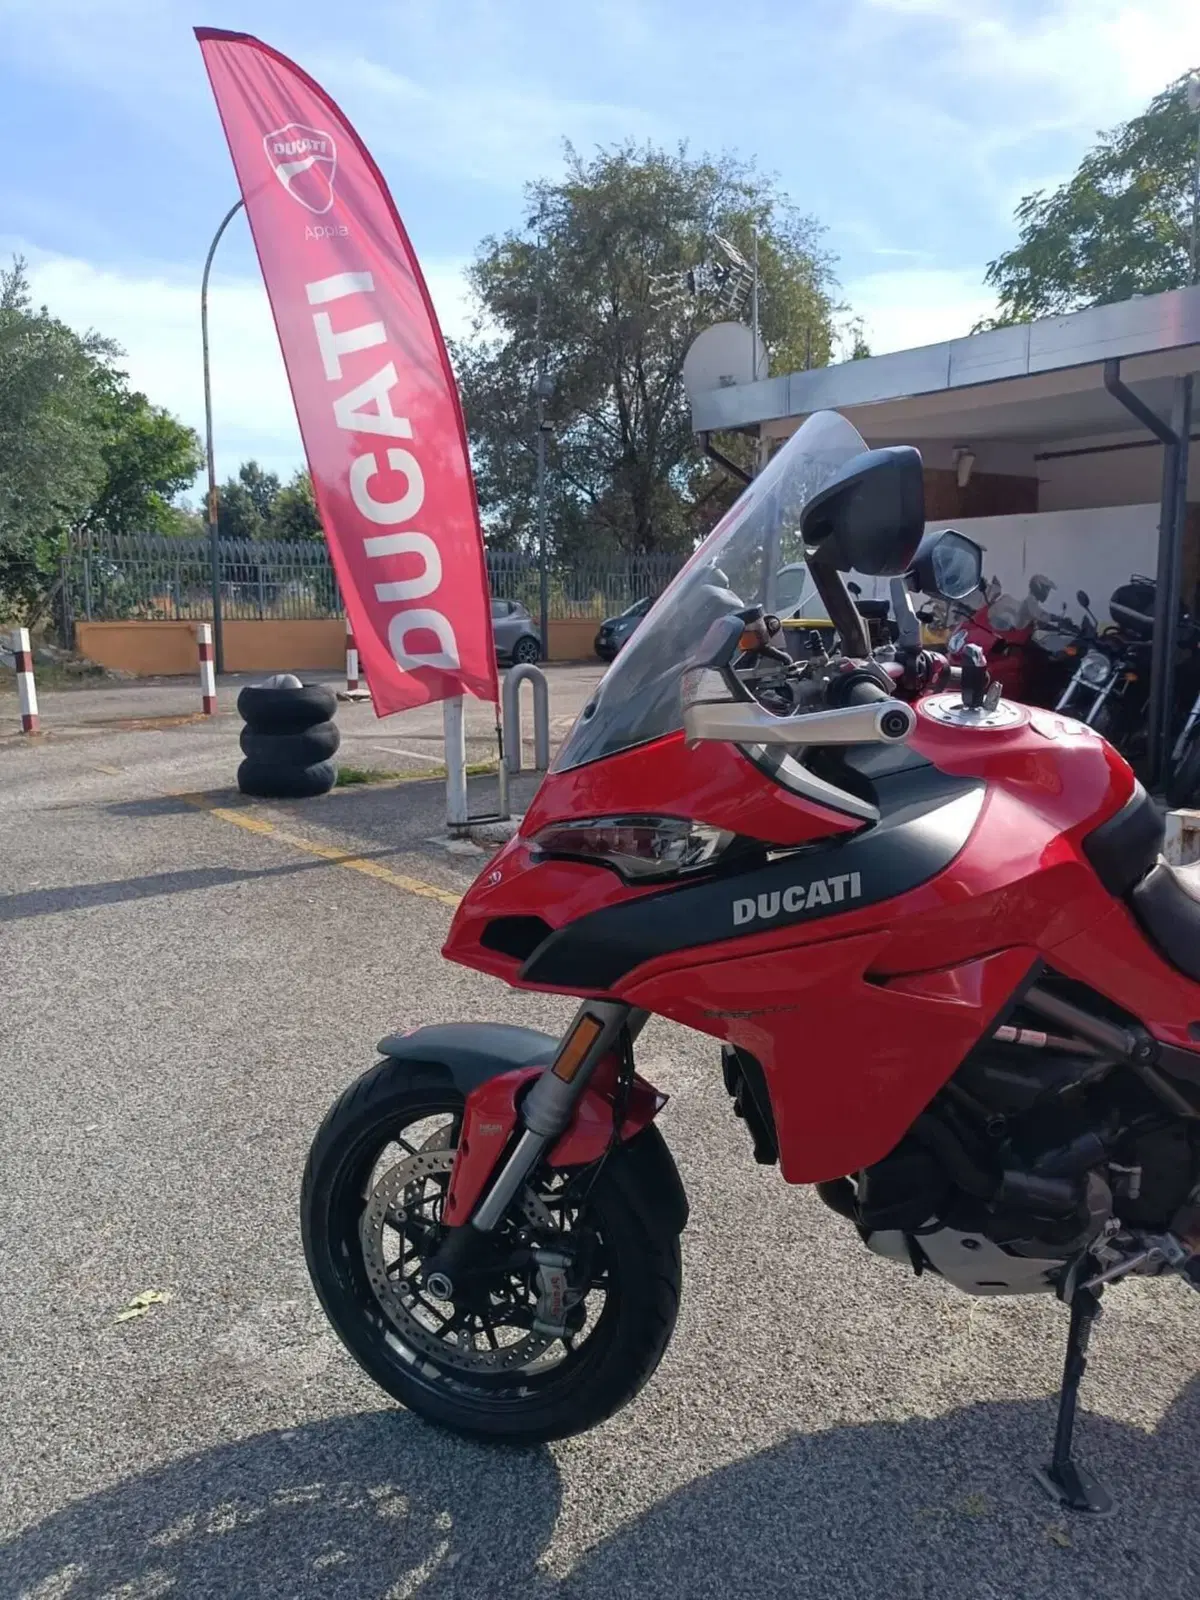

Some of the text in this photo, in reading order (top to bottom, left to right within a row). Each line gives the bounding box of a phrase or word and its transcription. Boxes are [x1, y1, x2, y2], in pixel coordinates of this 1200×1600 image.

[304, 225, 349, 241] Appia
[305, 271, 461, 673] DUCATI
[732, 871, 862, 926] DUCATI
